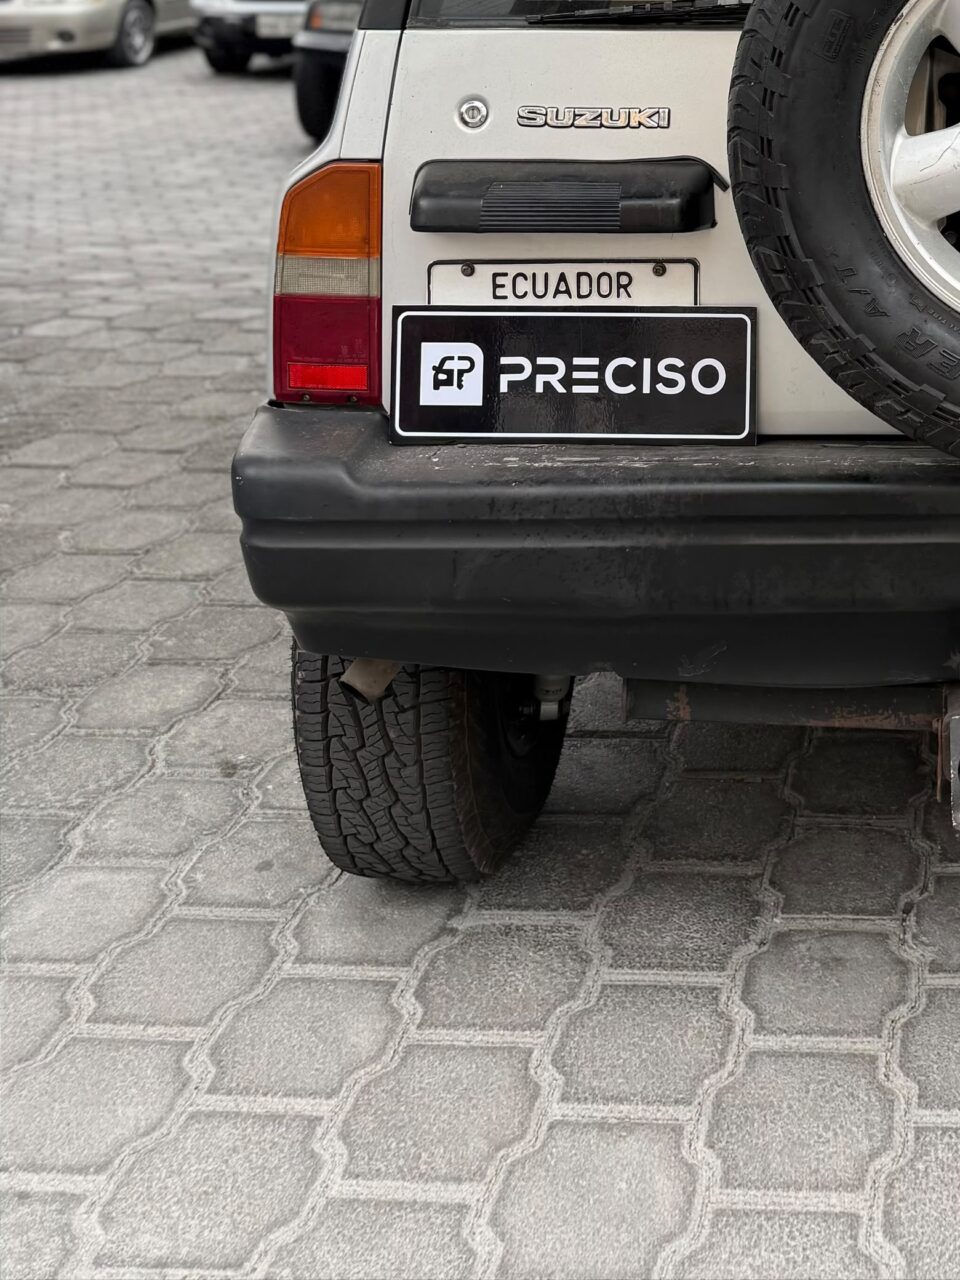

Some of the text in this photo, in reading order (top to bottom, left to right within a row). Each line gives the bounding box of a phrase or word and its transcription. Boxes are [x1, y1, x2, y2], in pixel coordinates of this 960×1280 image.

[517, 105, 671, 129] SUZUKI
[492, 271, 633, 300] ECUADOR
[500, 357, 727, 396] PRECISO
